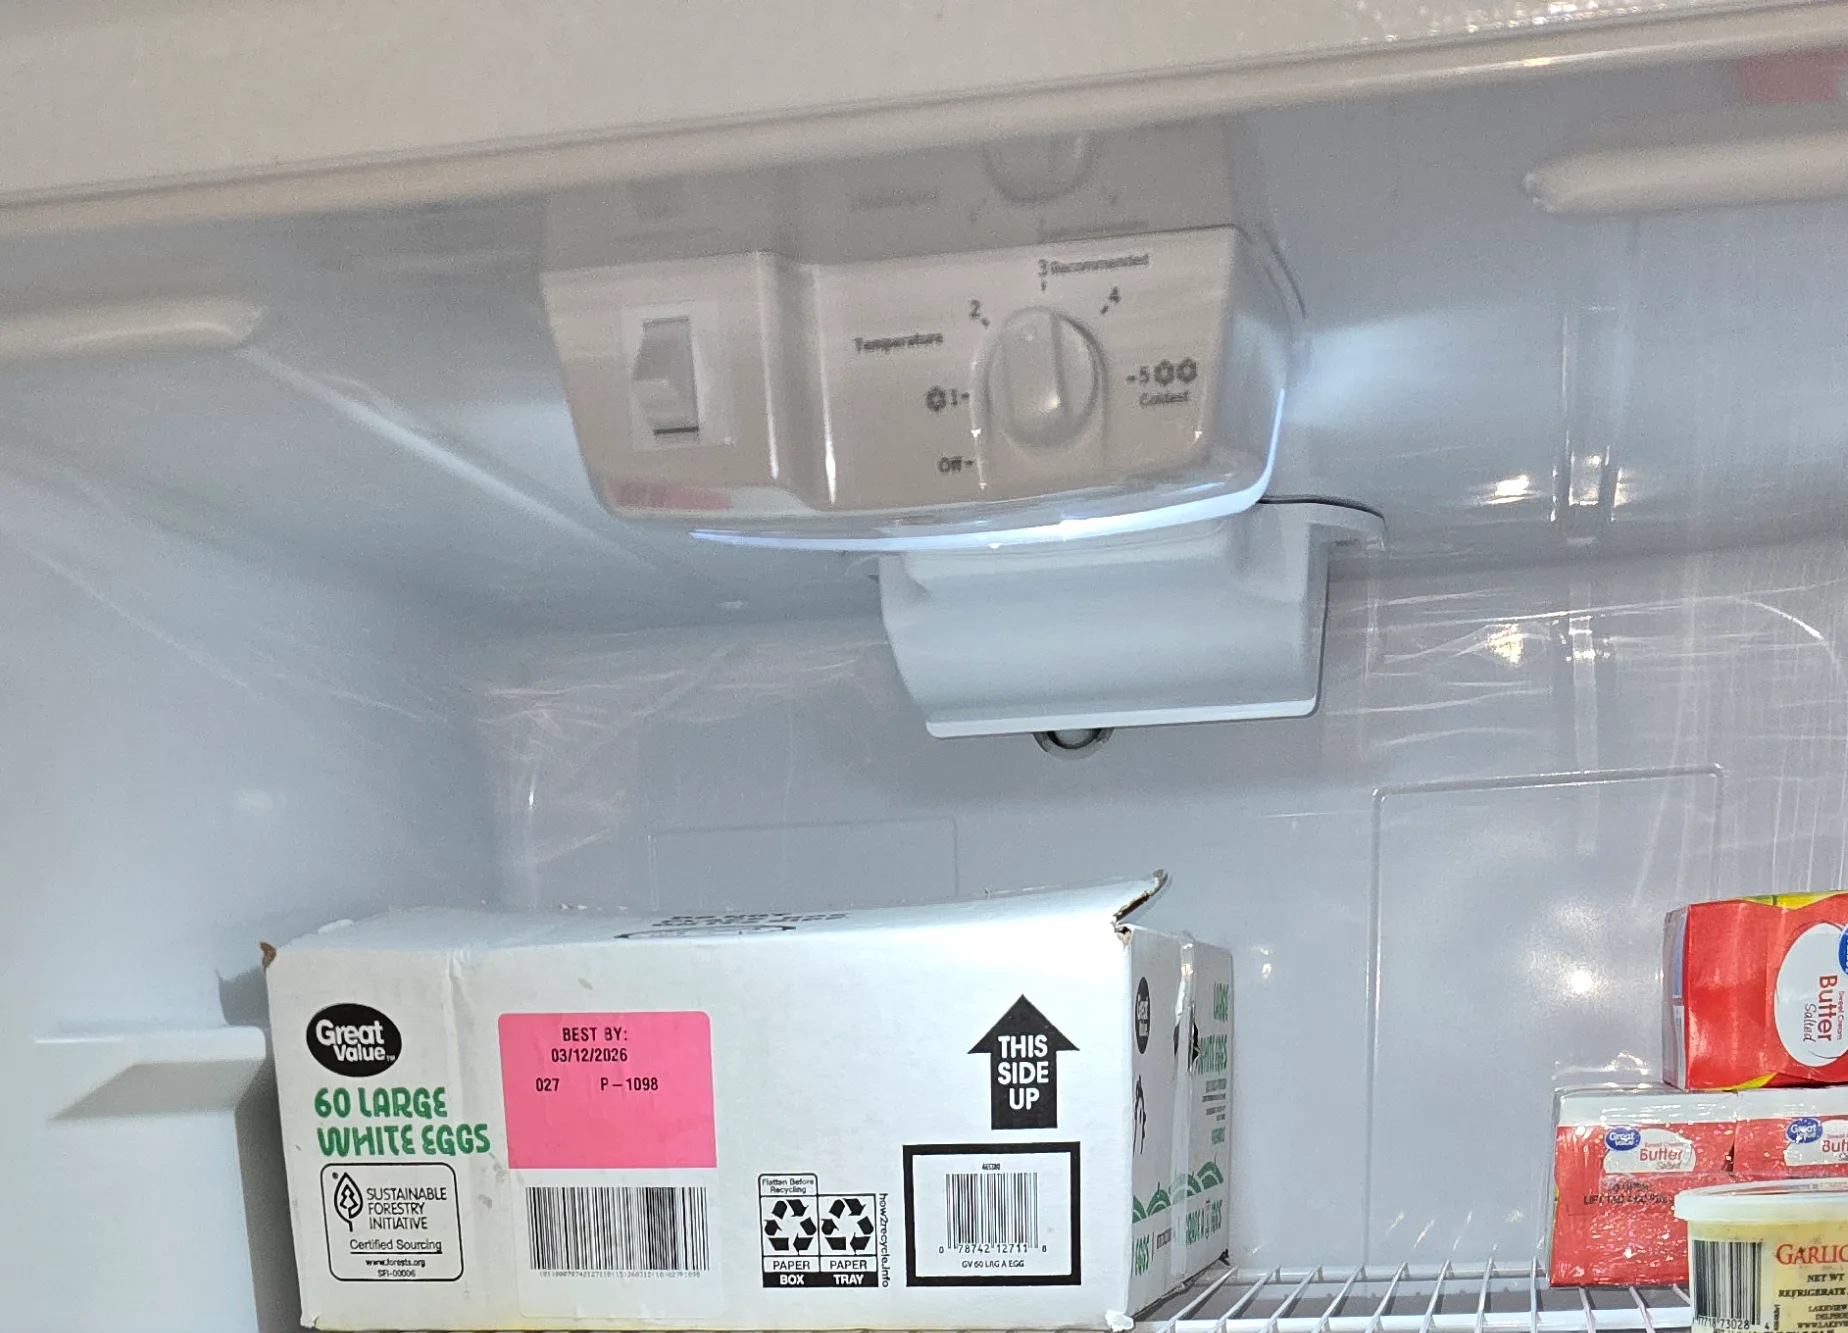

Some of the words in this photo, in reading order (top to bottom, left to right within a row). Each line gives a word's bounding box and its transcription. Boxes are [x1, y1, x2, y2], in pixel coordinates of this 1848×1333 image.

[1039, 259, 1047, 276] 3
[1051, 254, 1149, 274] Recommended
[1109, 287, 1120, 302] 4
[970, 299, 981, 319] 2
[854, 333, 943, 352] Temperature
[1139, 392, 1190, 407] Coldest
[938, 455, 962, 473] Off
[1818, 975, 1838, 1041] Butter
[1803, 1003, 1816, 1042] Salted
[315, 1018, 384, 1046] Great
[562, 1027, 597, 1041] BEST
[605, 1027, 628, 1041] BY:
[333, 1043, 386, 1062] Value
[998, 1034, 1048, 1058] THIS
[551, 1048, 628, 1063] 03/12/2026
[998, 1061, 1049, 1085] SIDE
[536, 1078, 560, 1092] 027
[314, 1087, 351, 1118] 60
[358, 1087, 447, 1119] LARGE
[1009, 1088, 1040, 1110] UP
[317, 1124, 416, 1157] WHITE
[421, 1124, 490, 1156] EGGS
[1640, 1148, 1683, 1162] Butter
[790, 1178, 814, 1186] Before
[366, 1187, 447, 1200] SUSTAINABLE
[770, 1186, 806, 1194] Recycling
[368, 1202, 425, 1215] FORESTRY
[369, 1217, 428, 1230] INITIATIVE
[350, 1239, 393, 1250] Certified
[396, 1239, 442, 1252] Sourcing
[879, 1193, 890, 1288] how2recycle.info
[958, 1244, 990, 1253] 78742
[997, 1244, 1027, 1253] 12711
[773, 1260, 810, 1270] PAPER
[830, 1260, 867, 1270] PAPER
[962, 1260, 972, 1268] GV
[1009, 1260, 1024, 1268] EGG
[780, 1274, 804, 1285] BOX
[833, 1274, 864, 1285] TRAY
[1807, 1274, 1827, 1282] NET
[1828, 1273, 1845, 1281] WT
[1778, 1287, 1846, 1298] REFRIGERATE
[1720, 1319, 1750, 1330] 73028
